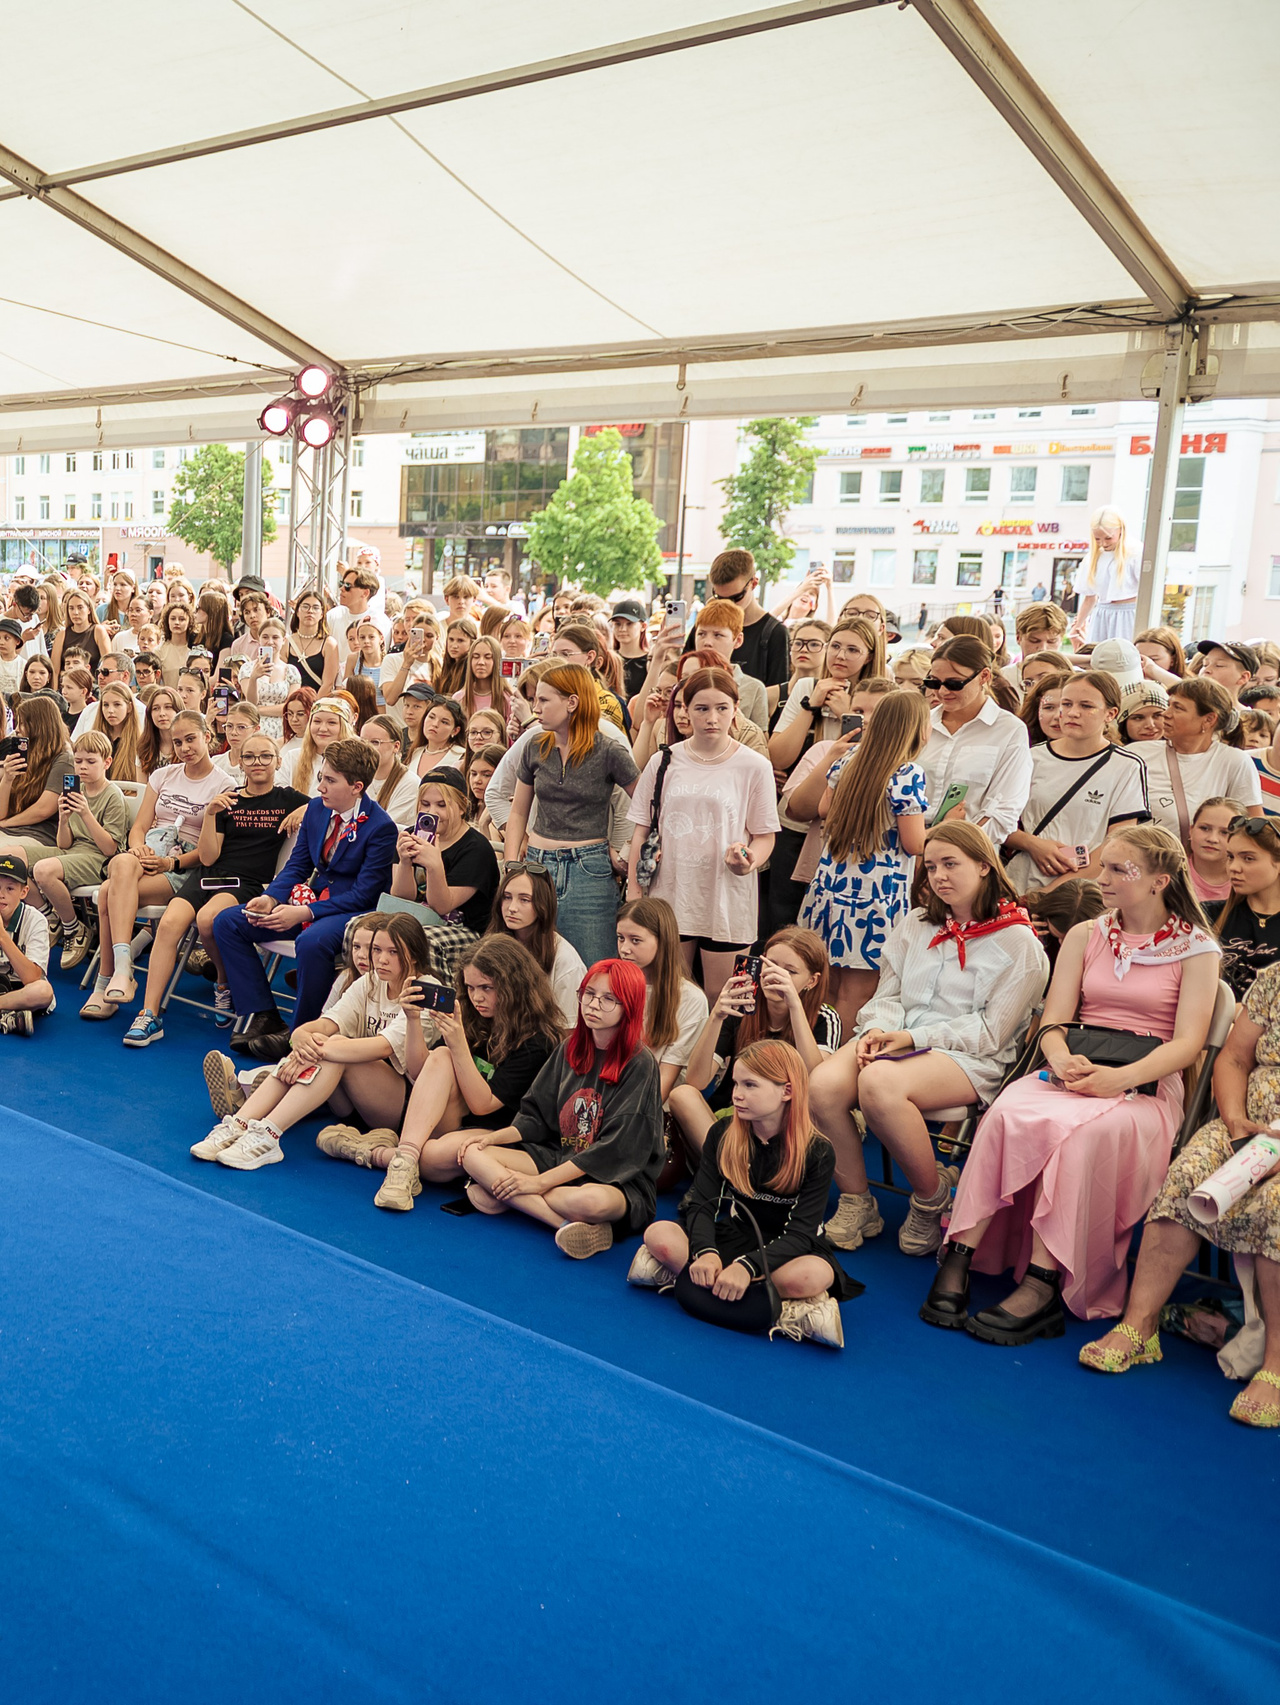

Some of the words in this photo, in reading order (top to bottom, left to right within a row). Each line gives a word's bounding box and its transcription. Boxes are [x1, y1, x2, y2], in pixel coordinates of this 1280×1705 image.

[1130, 432, 1227, 455] БНЯ
[976, 521, 1033, 535] ЛОМБАРД
[1037, 522, 1060, 533] WB
